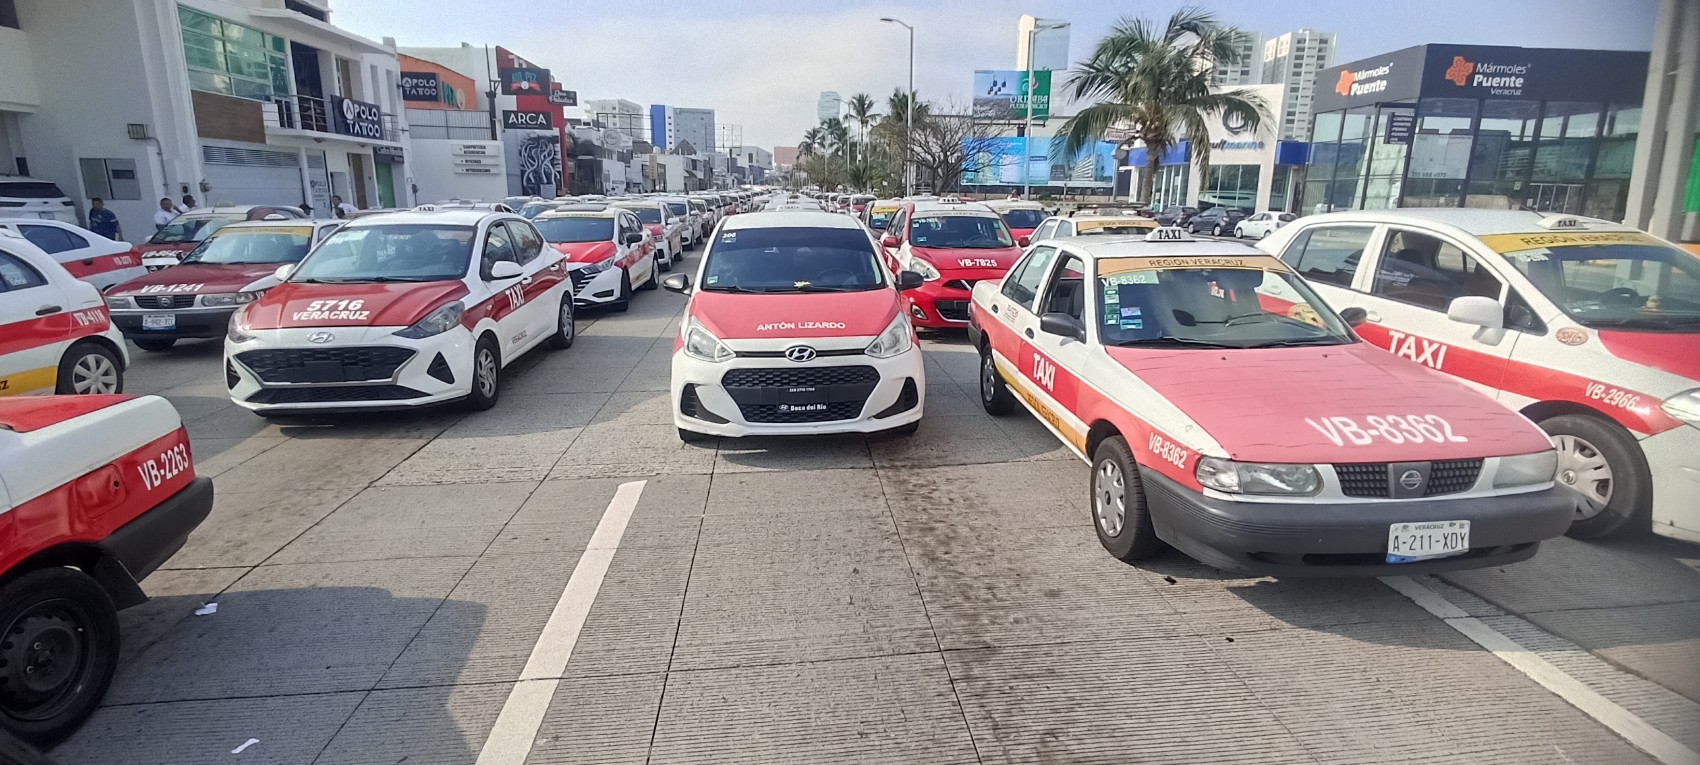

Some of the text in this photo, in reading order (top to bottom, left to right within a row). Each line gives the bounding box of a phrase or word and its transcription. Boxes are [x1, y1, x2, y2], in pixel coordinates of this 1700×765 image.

[1354, 65, 1389, 81] Mármoles
[1476, 62, 1526, 74] Mármoles
[1473, 74, 1524, 87] Puente
[405, 88, 437, 96] TATTOO
[1350, 79, 1387, 96] Puente
[1490, 87, 1522, 96] Veracruz
[508, 112, 547, 125] ARCA
[346, 119, 381, 138] TATTOO
[1557, 219, 1577, 228] TAXI
[1157, 229, 1182, 240] TAXI
[957, 259, 998, 267] VB-7825
[1192, 258, 1245, 266] VERACRUZ
[1101, 274, 1147, 287] VB-8362
[140, 283, 204, 294] VB-1241
[505, 283, 525, 310] TAXI
[306, 299, 365, 312] 5716
[292, 310, 371, 321] VERACRUZ
[756, 321, 846, 331] ANTÓN LIZARDO
[1388, 329, 1448, 370] TAXI
[1033, 352, 1056, 392] TAXI
[1585, 381, 1640, 411] VB-2966
[1304, 414, 1469, 447] VB-8362
[1148, 431, 1187, 469] VB-8362
[137, 443, 189, 491] VB-2263
[1392, 532, 1467, 552] A-211-XDY
